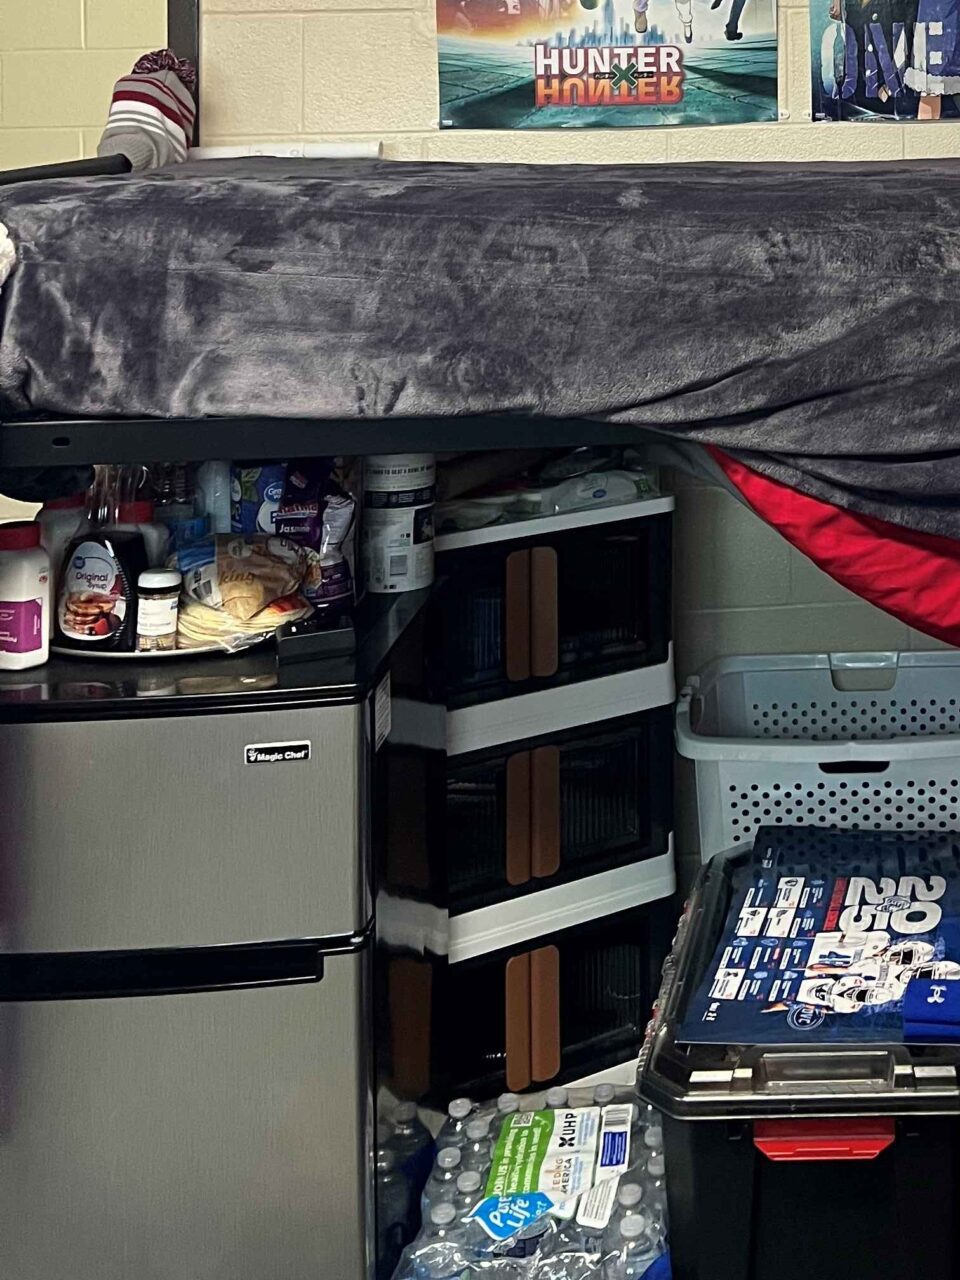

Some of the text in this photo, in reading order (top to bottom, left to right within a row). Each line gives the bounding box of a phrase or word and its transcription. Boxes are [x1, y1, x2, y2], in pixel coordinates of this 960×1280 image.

[535, 44, 682, 75] HUNTER
[821, 21, 945, 99] ONE
[280, 524, 310, 533] Jasmine
[76, 572, 108, 583] Original
[257, 750, 305, 762] Magic Chef
[562, 1112, 578, 1136] UHP
[560, 1158, 572, 1195] AMERICA
[506, 1198, 530, 1228] Life
